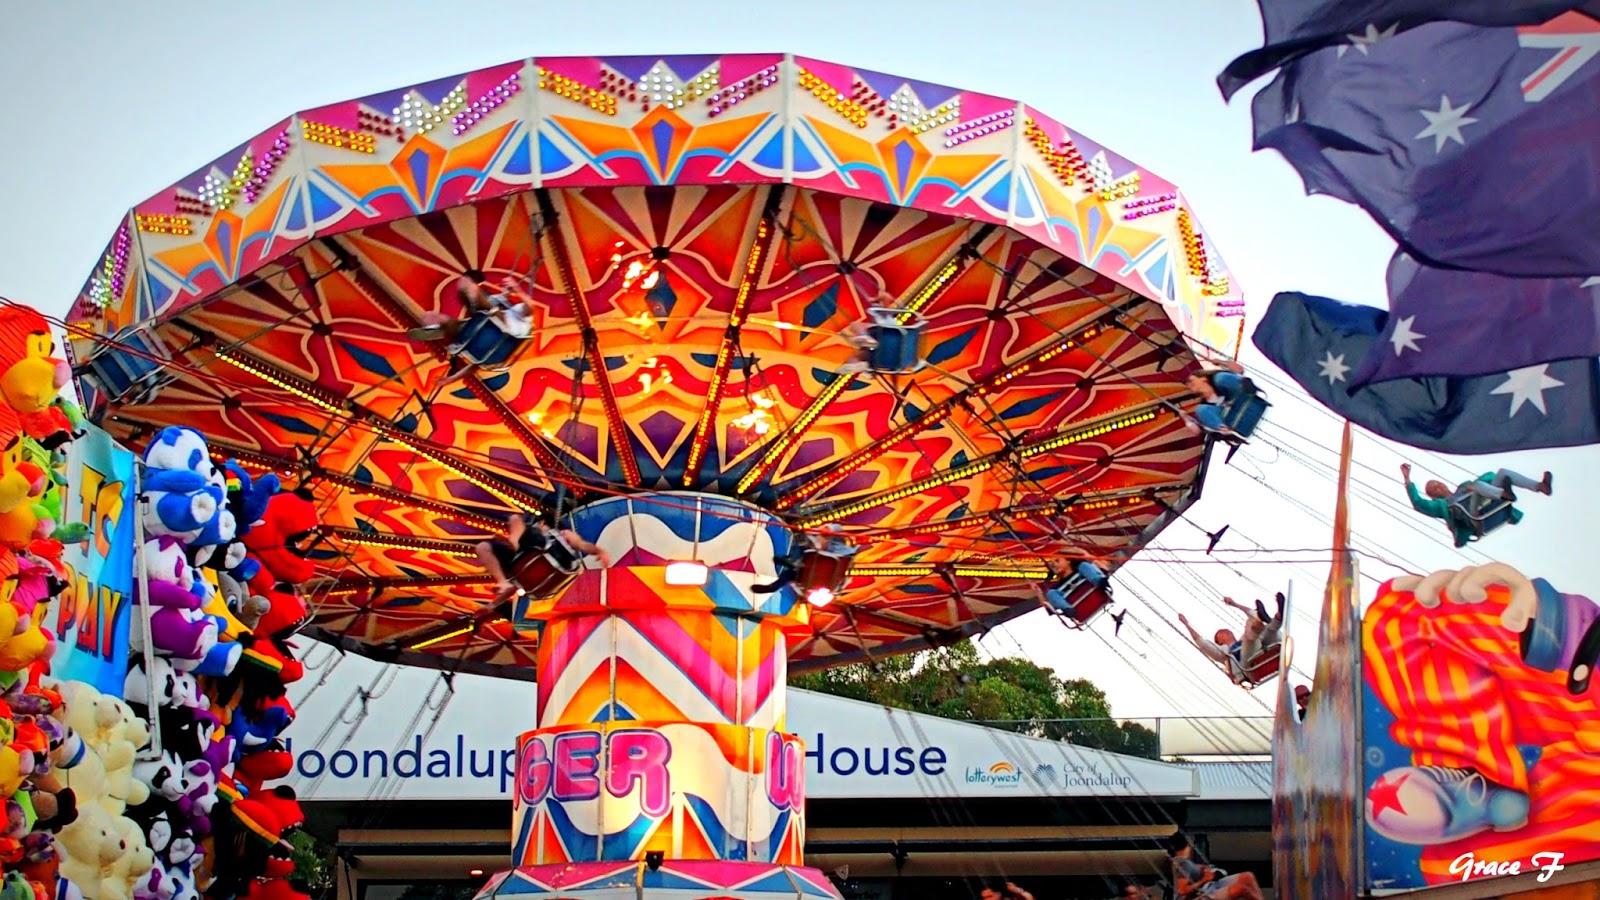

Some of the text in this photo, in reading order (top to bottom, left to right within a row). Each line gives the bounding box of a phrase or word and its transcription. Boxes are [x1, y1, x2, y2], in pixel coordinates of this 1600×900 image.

[514, 729, 672, 817] GER
[965, 766, 1022, 785] lotterywest
[1063, 761, 1098, 774] City of
[1063, 772, 1132, 789] Joondalup
